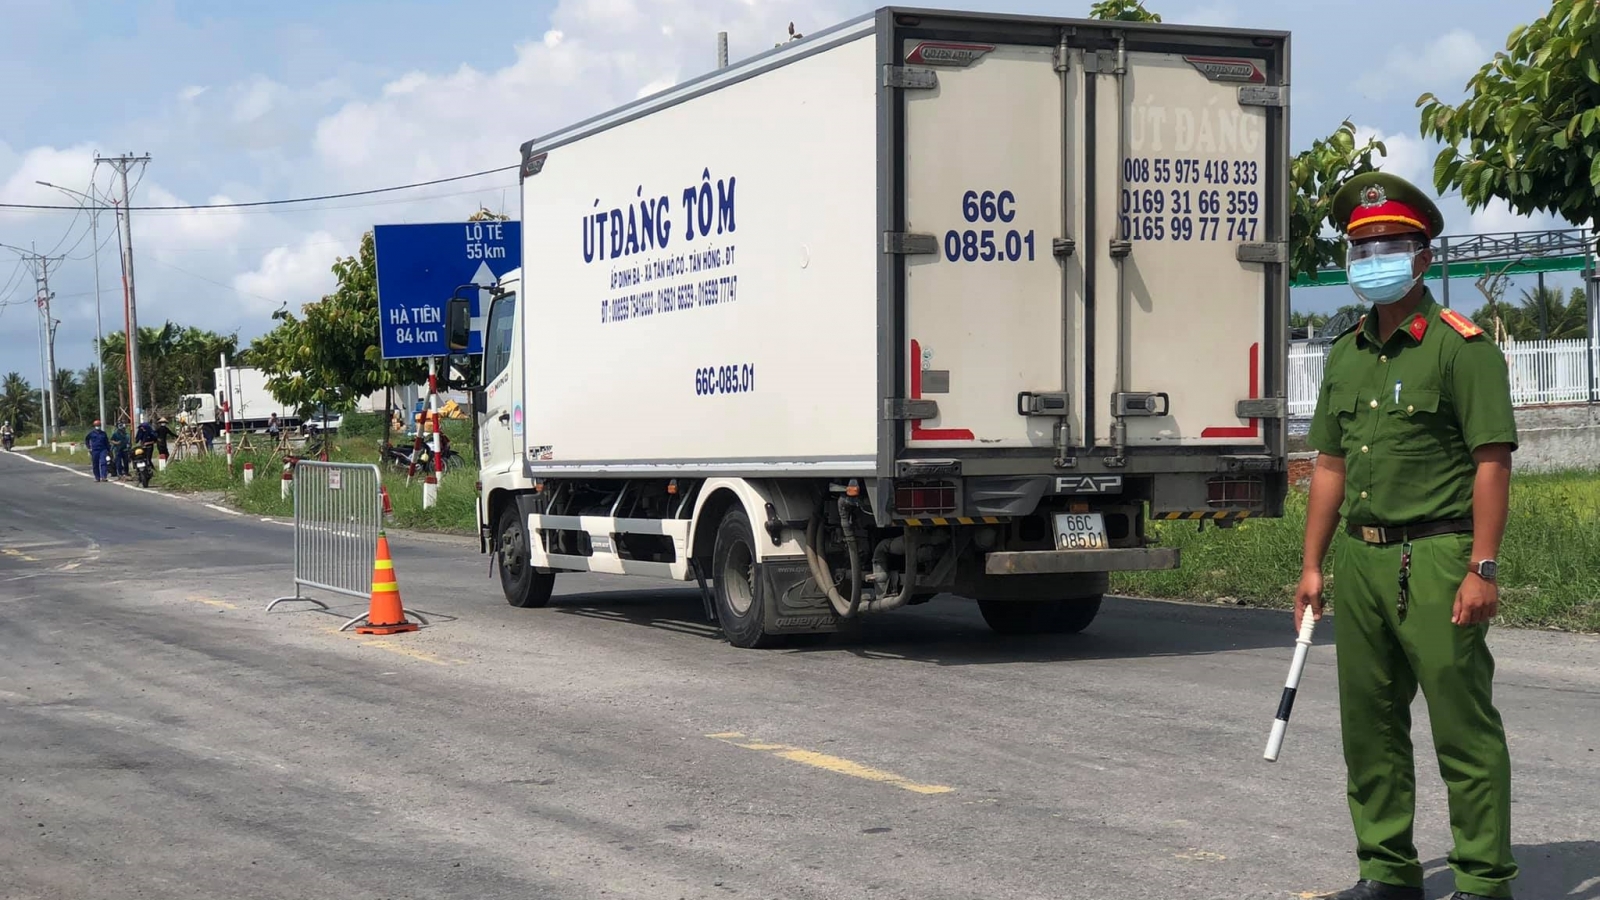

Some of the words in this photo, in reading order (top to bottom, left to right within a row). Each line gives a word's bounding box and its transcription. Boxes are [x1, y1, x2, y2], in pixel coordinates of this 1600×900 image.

[1124, 157, 1150, 183] 008
[1154, 158, 1171, 184] 55
[1175, 159, 1200, 184] 975
[1204, 160, 1229, 185] 418
[1233, 160, 1258, 185] 333
[682, 167, 736, 241] TÔM
[962, 189, 1016, 223] 66C
[1122, 189, 1165, 215] 0169
[1171, 189, 1192, 215] 31
[1199, 190, 1220, 215] 66
[1226, 190, 1259, 216] 359
[1122, 216, 1165, 241] 0165
[1171, 216, 1193, 241] 99
[1199, 217, 1220, 242] 77
[1226, 217, 1258, 242] 747
[466, 244, 483, 260] 55
[484, 243, 506, 259] km
[944, 229, 1035, 262] 085.01
[390, 303, 410, 325] HÀ
[411, 304, 441, 324] TIÊN
[396, 328, 414, 343] 84
[416, 327, 438, 343] km
[695, 362, 754, 396] 66C-085.01
[1066, 515, 1093, 531] 66C
